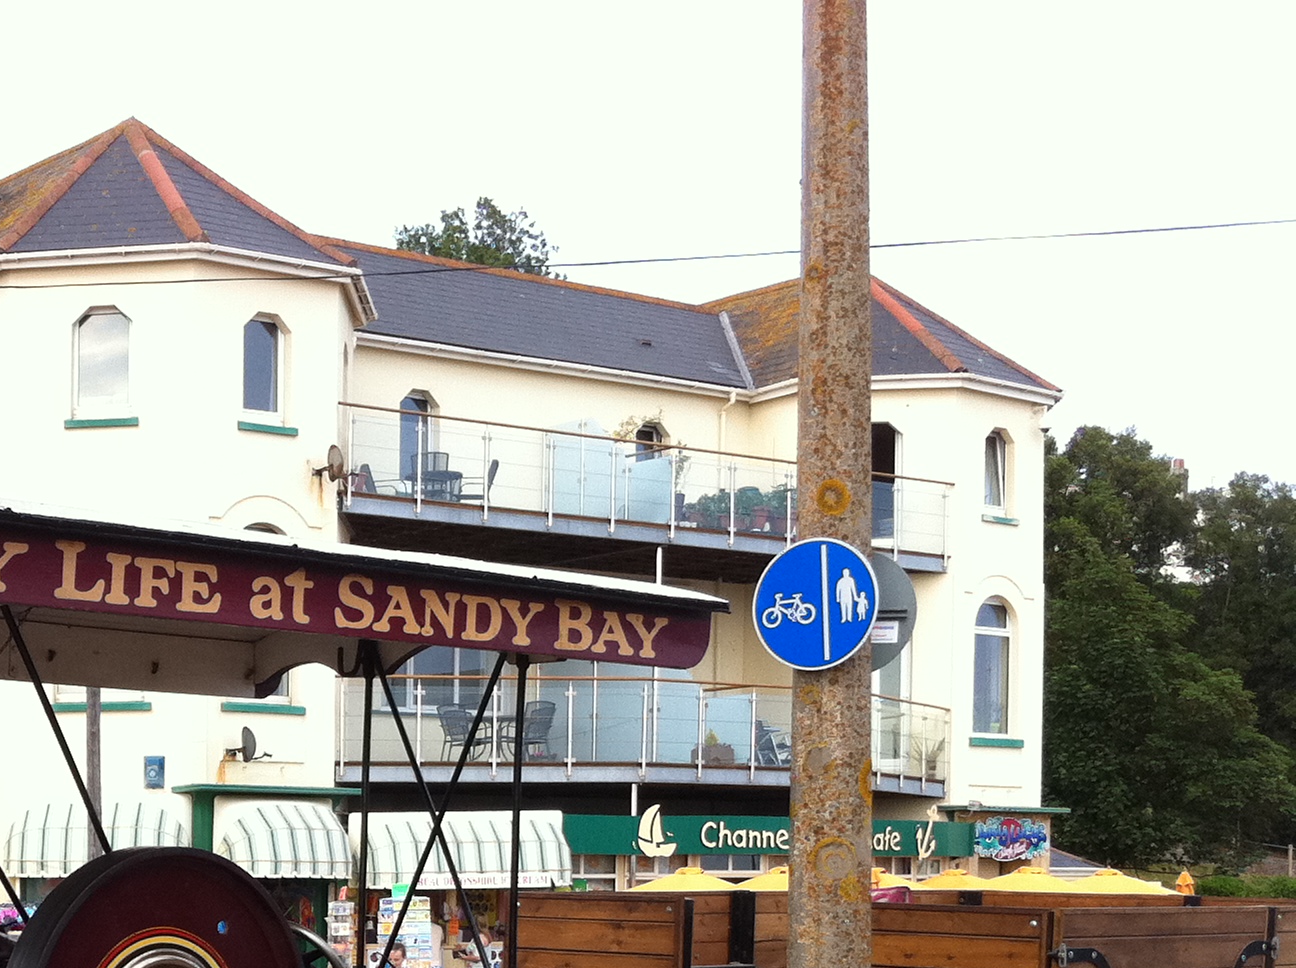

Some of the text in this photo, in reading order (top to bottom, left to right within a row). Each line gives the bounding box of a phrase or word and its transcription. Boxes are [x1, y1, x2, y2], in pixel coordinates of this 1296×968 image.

[53, 539, 222, 613] LIFE
[249, 569, 314, 624] at
[334, 574, 551, 646] SANDY
[553, 601, 668, 658] BAY
[701, 821, 901, 851] Channe afe
[519, 875, 548, 885] REAM
